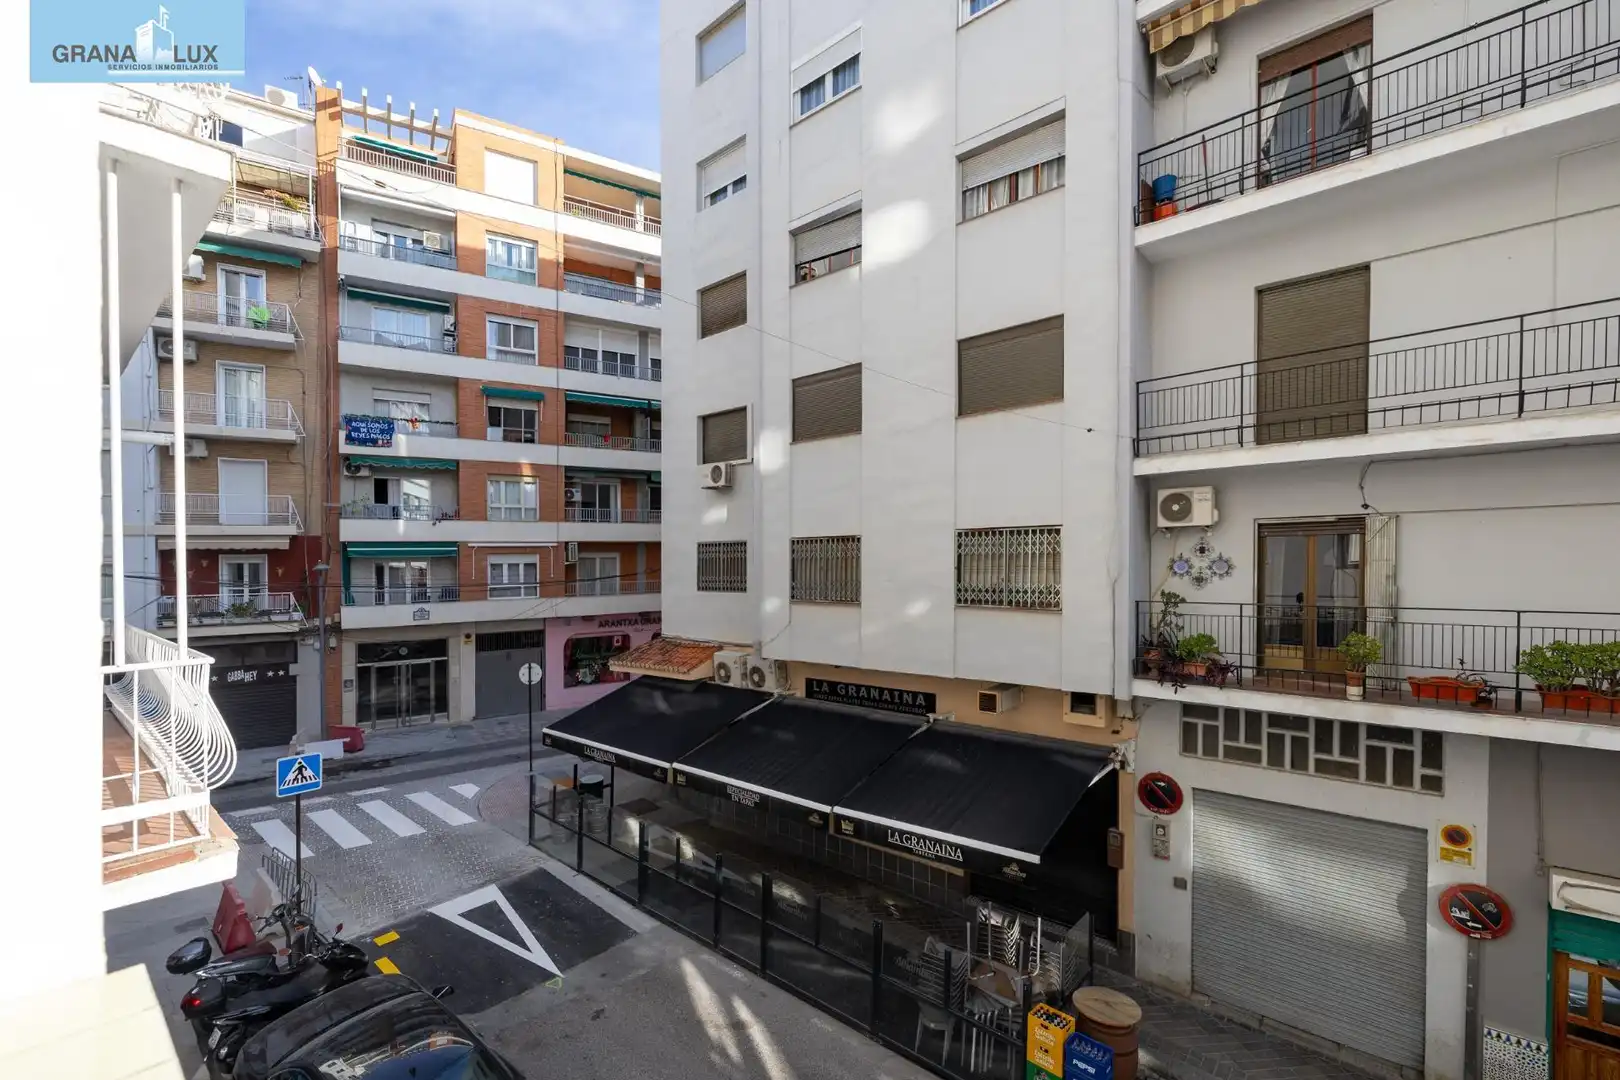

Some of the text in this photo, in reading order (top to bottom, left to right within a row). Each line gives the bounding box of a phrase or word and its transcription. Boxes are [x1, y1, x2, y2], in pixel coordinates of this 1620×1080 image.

[598, 618, 639, 628] ARANTXA
[244, 670, 258, 682] HEY
[812, 680, 830, 693] LA
[836, 683, 927, 706] GRANAINA
[887, 829, 964, 860] LA GRANAINA
